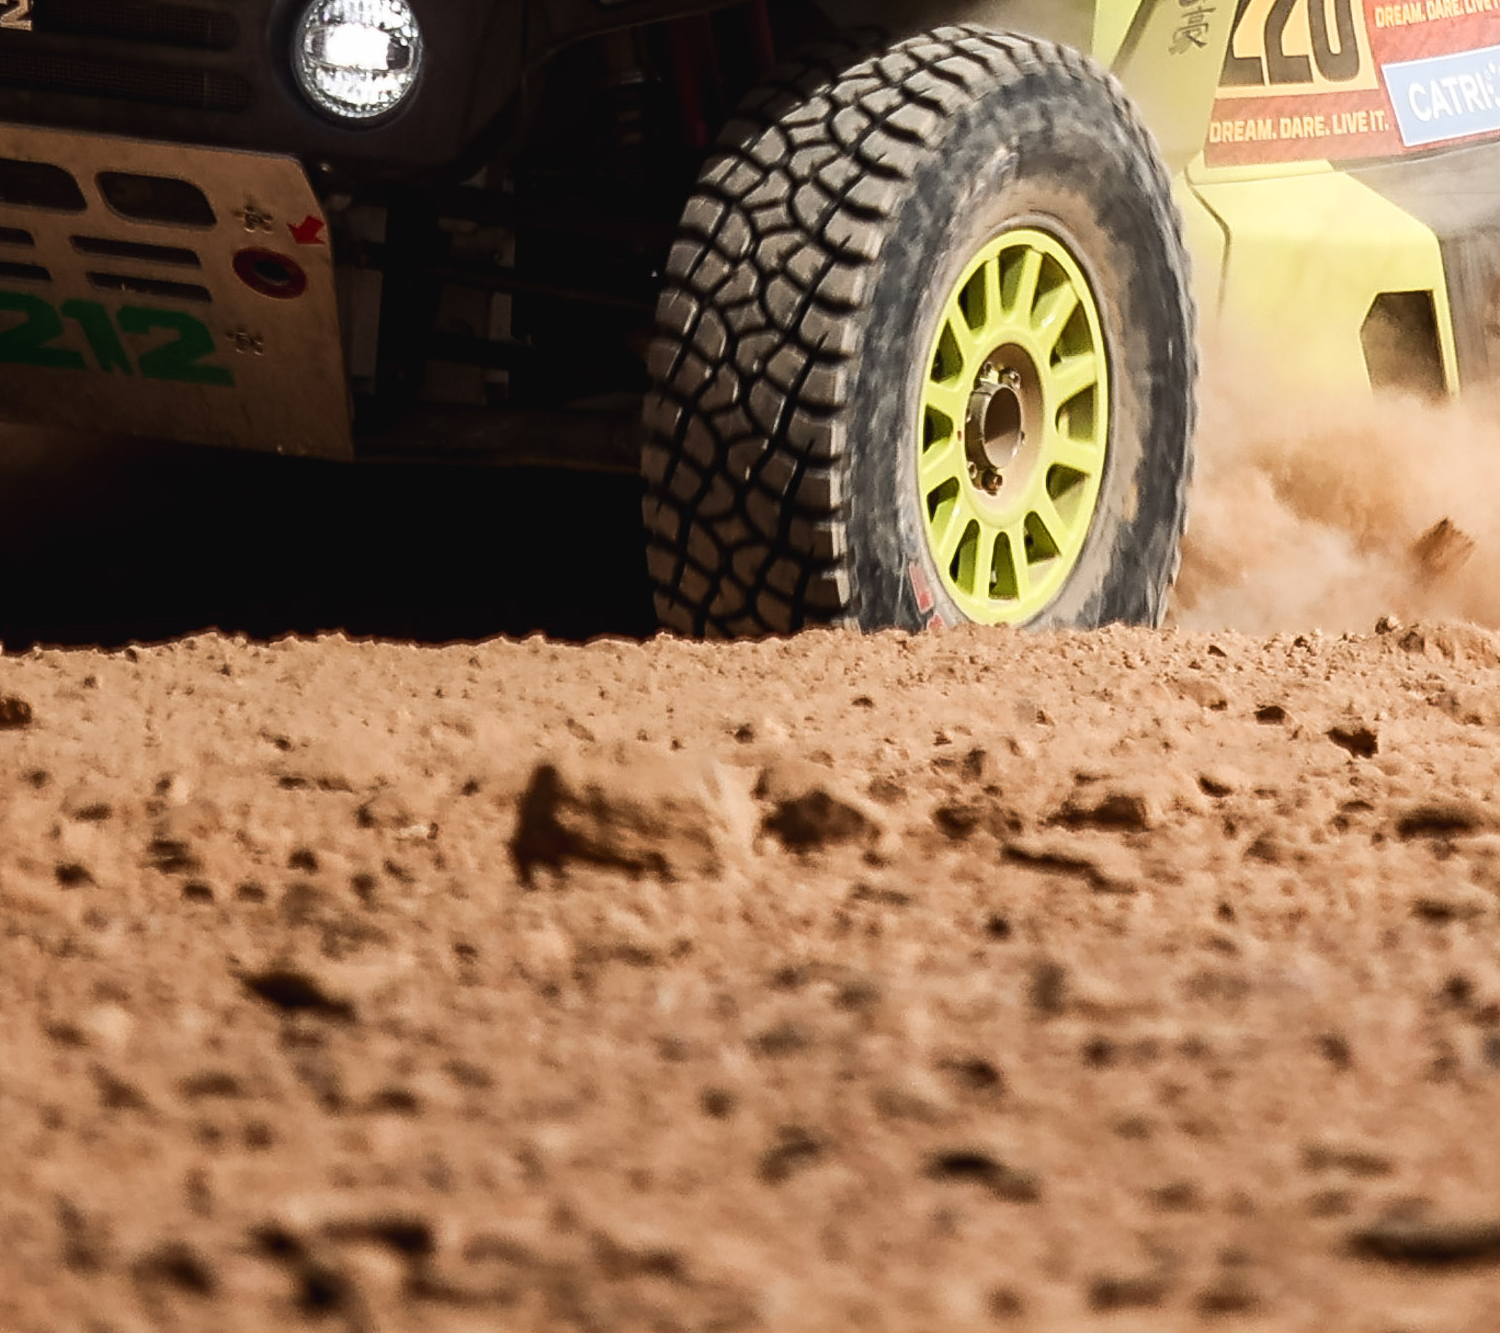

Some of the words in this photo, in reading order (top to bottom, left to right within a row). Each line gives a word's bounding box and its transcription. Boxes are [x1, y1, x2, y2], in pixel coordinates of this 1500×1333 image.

[1374, 2, 1426, 28] DREAM.
[1209, 117, 1278, 143] DREAM.
[1280, 115, 1331, 140] DARE.
[1332, 112, 1369, 136] LIVE
[1369, 110, 1390, 132] IT.
